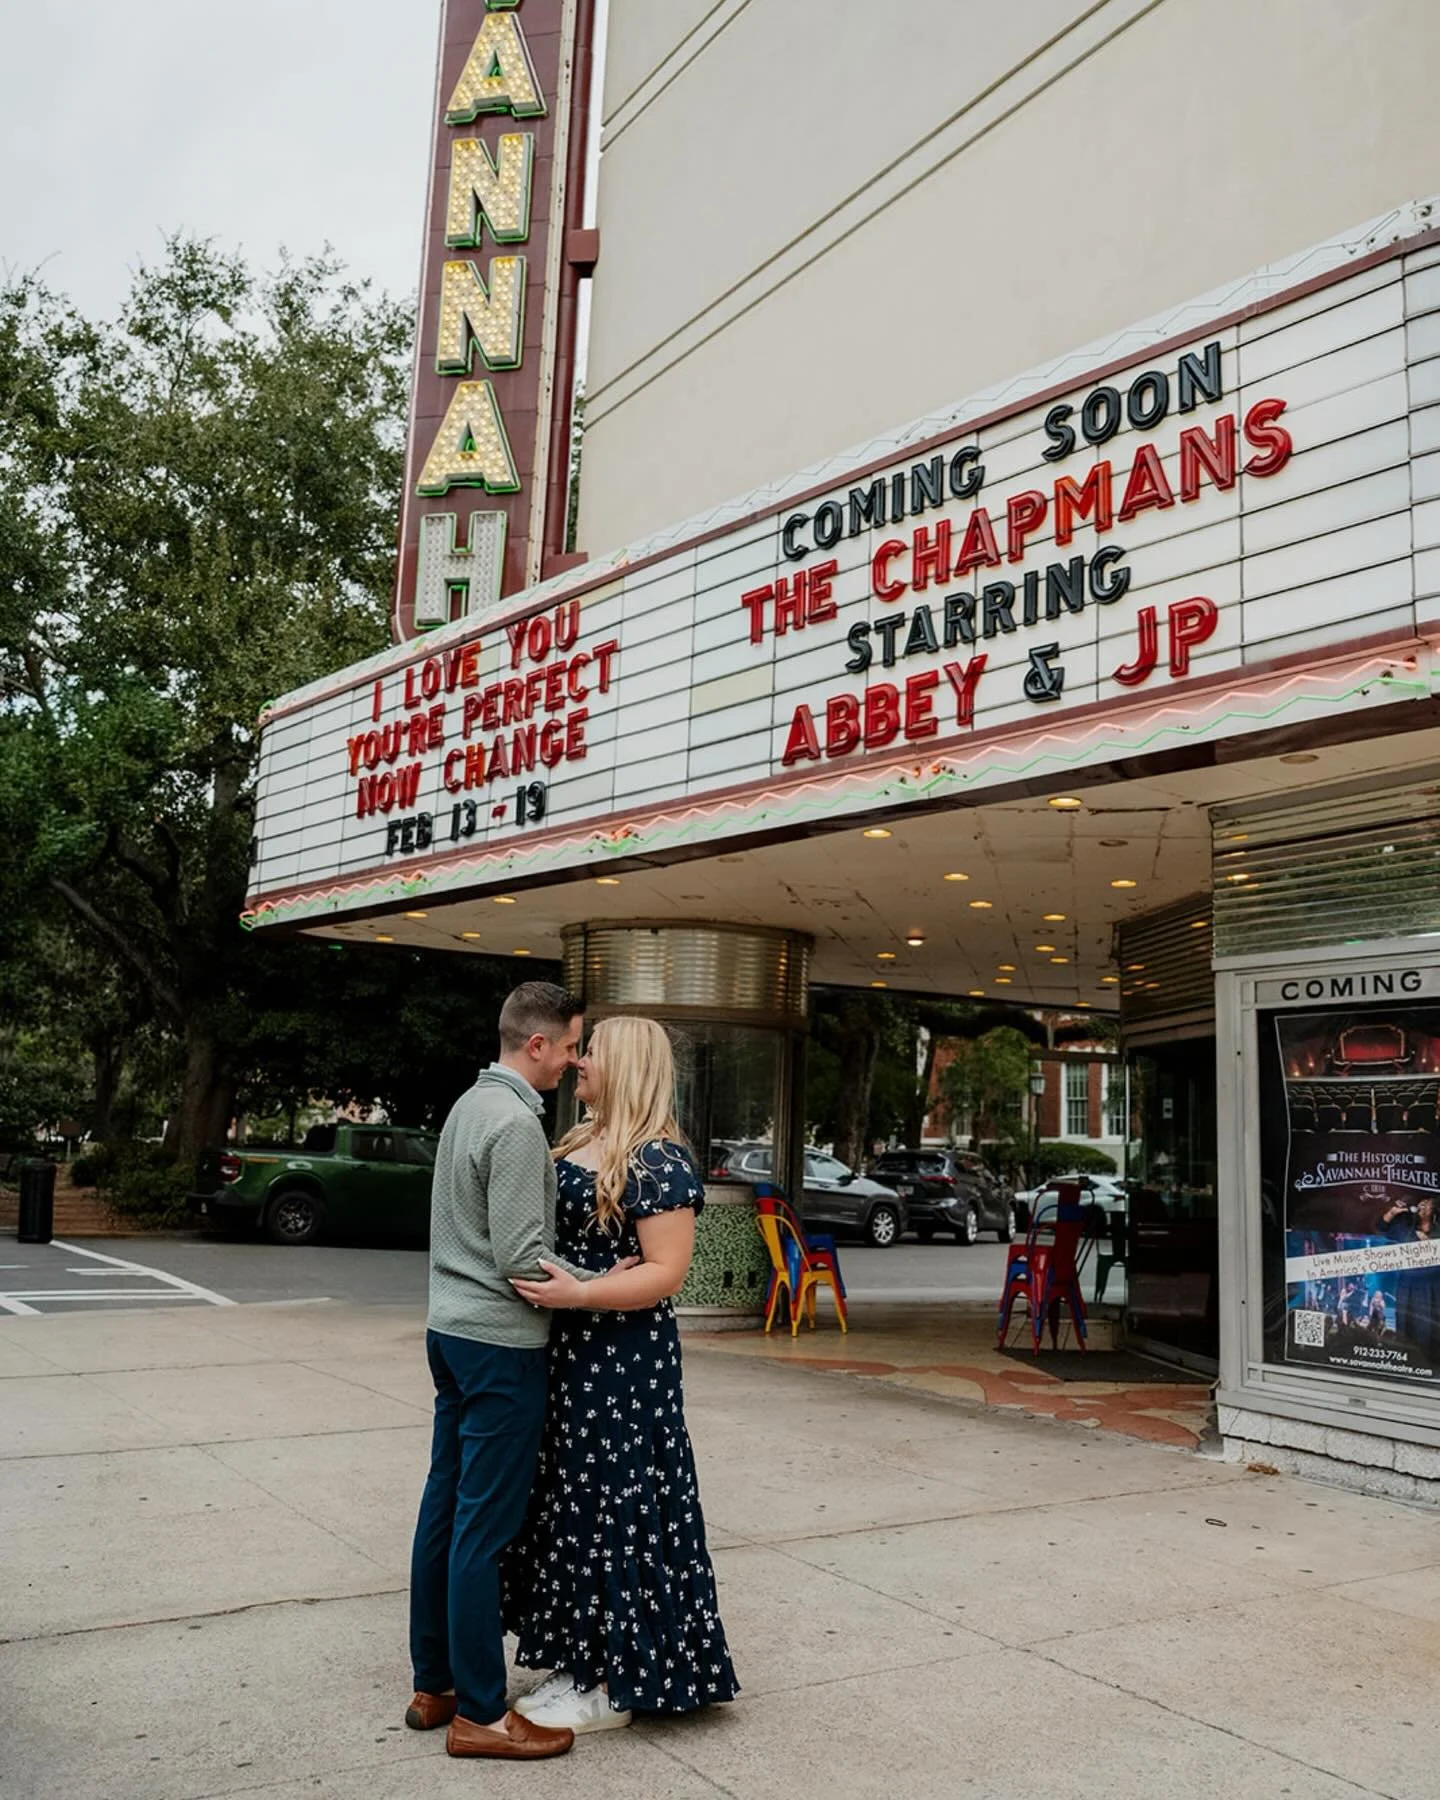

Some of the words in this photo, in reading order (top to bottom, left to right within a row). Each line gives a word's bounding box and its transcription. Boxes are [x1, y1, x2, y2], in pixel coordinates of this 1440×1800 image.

[414, 0, 547, 630] ANNAH
[782, 446, 986, 561] COMING
[1042, 341, 1224, 462] SOON
[741, 560, 838, 645] THE
[871, 399, 1294, 602] CHAPMANS
[372, 680, 382, 722] I
[404, 640, 481, 709] LOVE
[505, 600, 580, 670] YOU
[845, 545, 1131, 674] STARRING
[347, 703, 445, 776] YOU'RE
[462, 639, 620, 739] PERFECT
[781, 654, 989, 766] ABBEY
[1024, 642, 1064, 702] &
[1112, 596, 1219, 685] JP
[356, 762, 422, 819] NOW
[444, 708, 589, 793] CHANGE
[386, 812, 433, 856] FEB
[450, 799, 476, 841] 13
[516, 781, 547, 826] 19
[1281, 971, 1422, 1000] COMING
[1316, 1163, 1380, 1183] SAVANNAH
[1381, 1164, 1439, 1187] THEATRE
[1338, 1151, 1359, 1162] THE
[1361, 1151, 1413, 1164] HISTORIC
[1306, 1269, 1317, 1278] In
[1320, 1263, 1366, 1277] America's
[1369, 1260, 1403, 1272] Oldest
[1406, 1255, 1440, 1268] Theatr
[1313, 1257, 1331, 1267] Live
[1334, 1253, 1361, 1263] Music
[1364, 1249, 1397, 1260] Shows
[1400, 1241, 1438, 1257] Nightly
